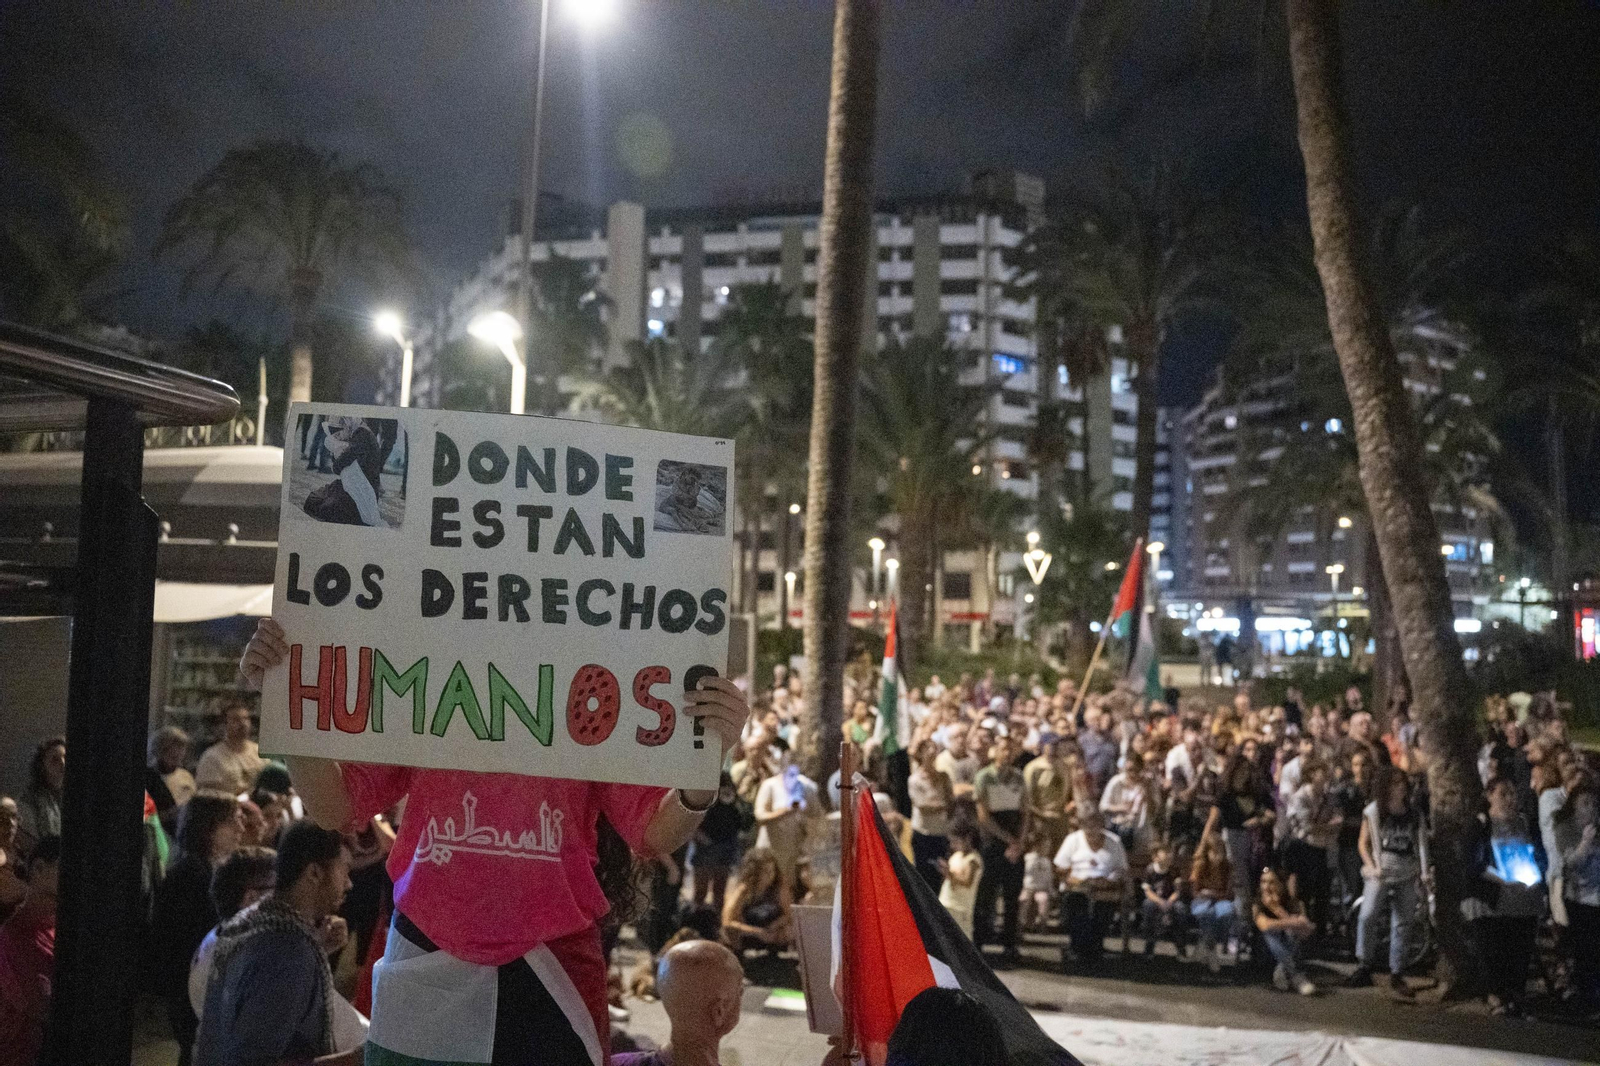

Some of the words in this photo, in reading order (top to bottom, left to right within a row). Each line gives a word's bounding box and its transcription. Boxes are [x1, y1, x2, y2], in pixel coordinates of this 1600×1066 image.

[432, 430, 634, 502] DONDE
[430, 497, 645, 559] ESTAN
[286, 552, 385, 610] LOS
[420, 568, 728, 636] DERECHOS
